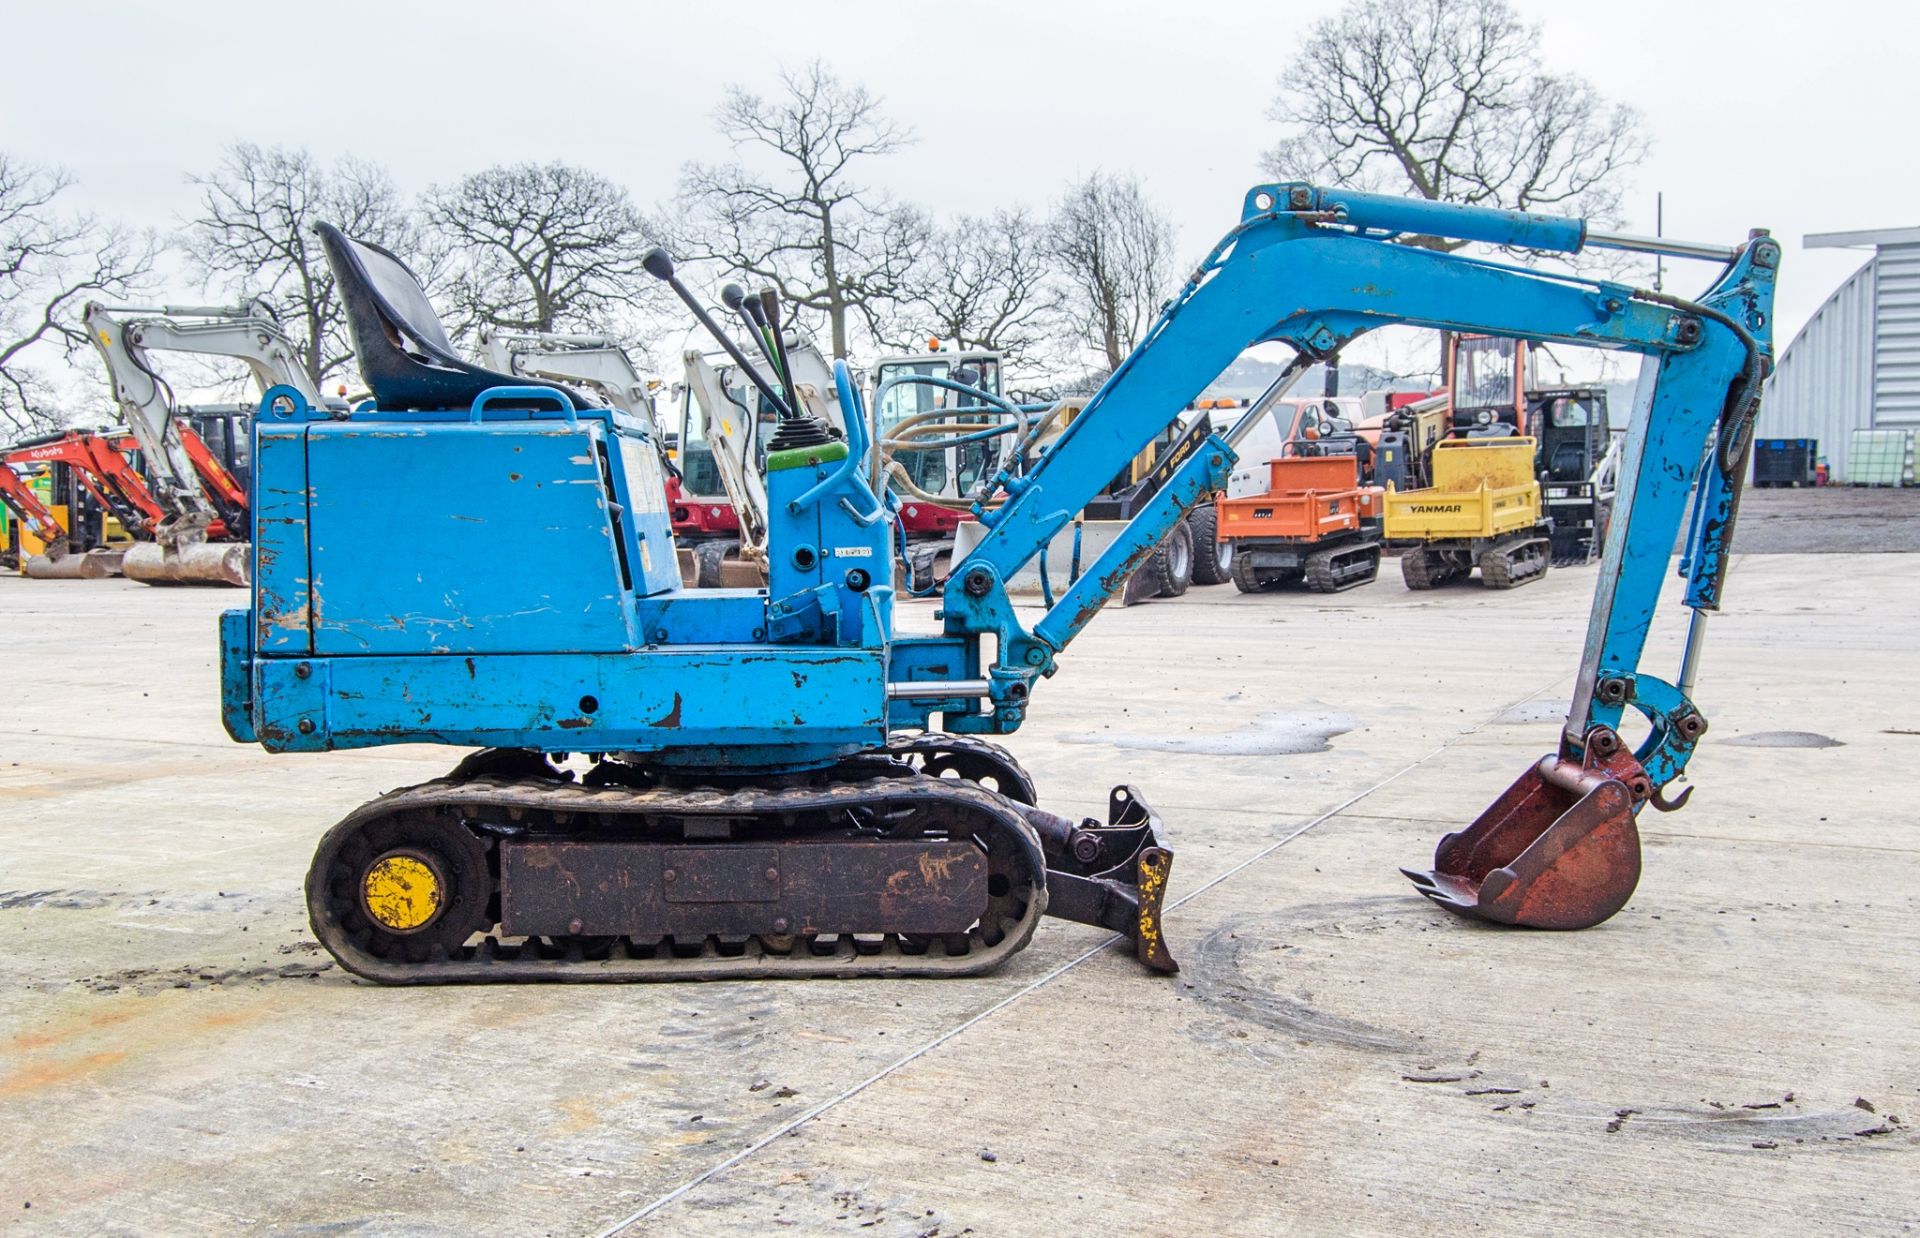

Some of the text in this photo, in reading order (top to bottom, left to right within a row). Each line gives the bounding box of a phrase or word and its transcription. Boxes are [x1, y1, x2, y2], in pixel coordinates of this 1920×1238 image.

[31, 447, 63, 458] Kubota
[1170, 440, 1191, 469] FORD
[1410, 505, 1462, 513] YANMAR
